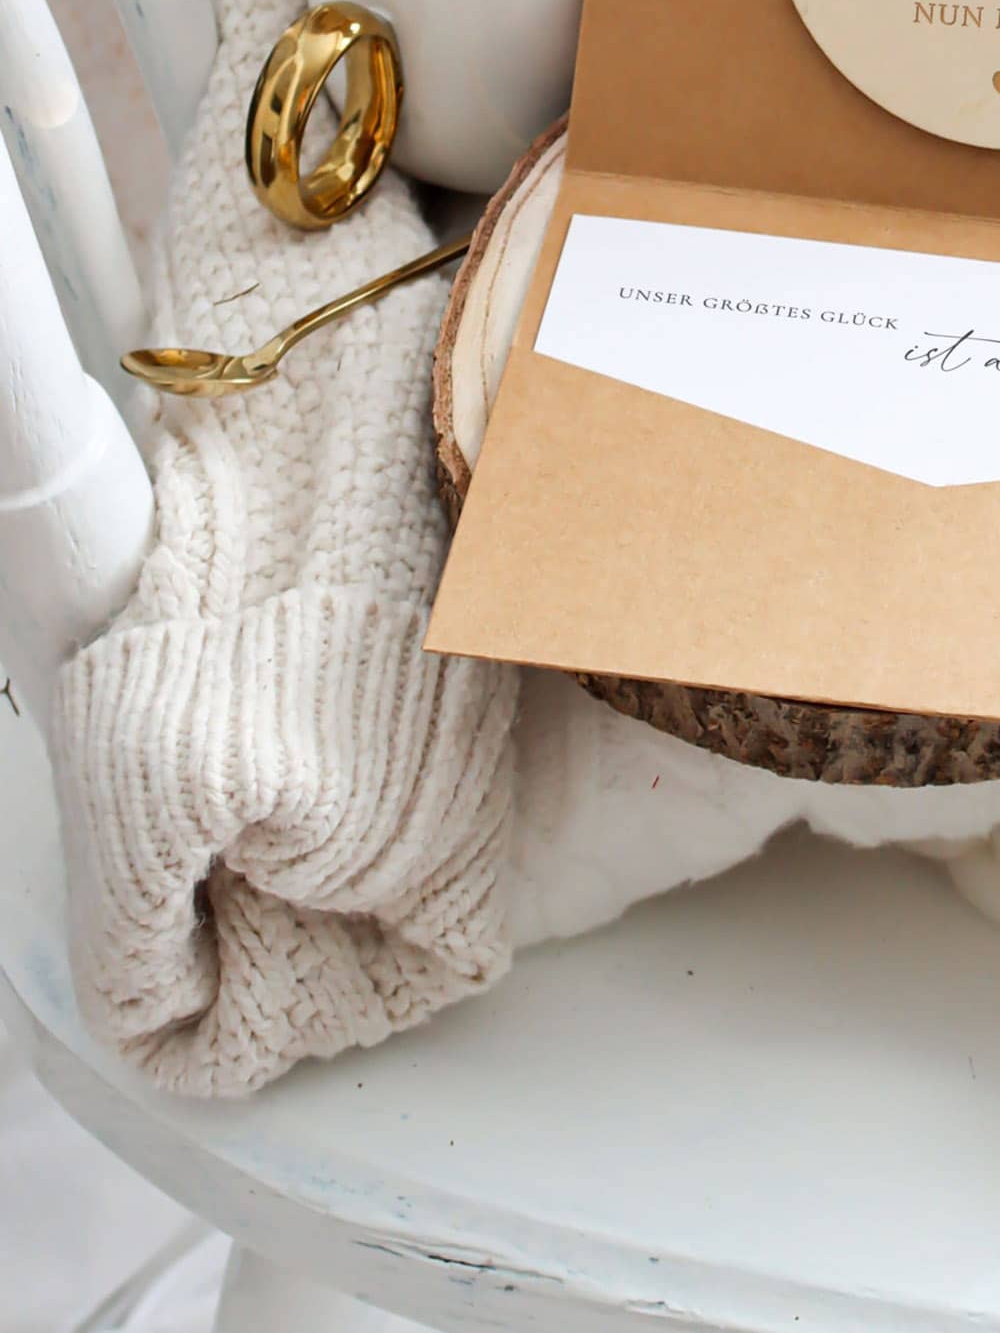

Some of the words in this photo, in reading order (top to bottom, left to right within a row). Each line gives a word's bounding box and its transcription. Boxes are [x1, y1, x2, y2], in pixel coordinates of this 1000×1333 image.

[912, 2, 983, 28] NUN
[619, 287, 693, 307] UNSER
[820, 310, 899, 330] GLÜCK
